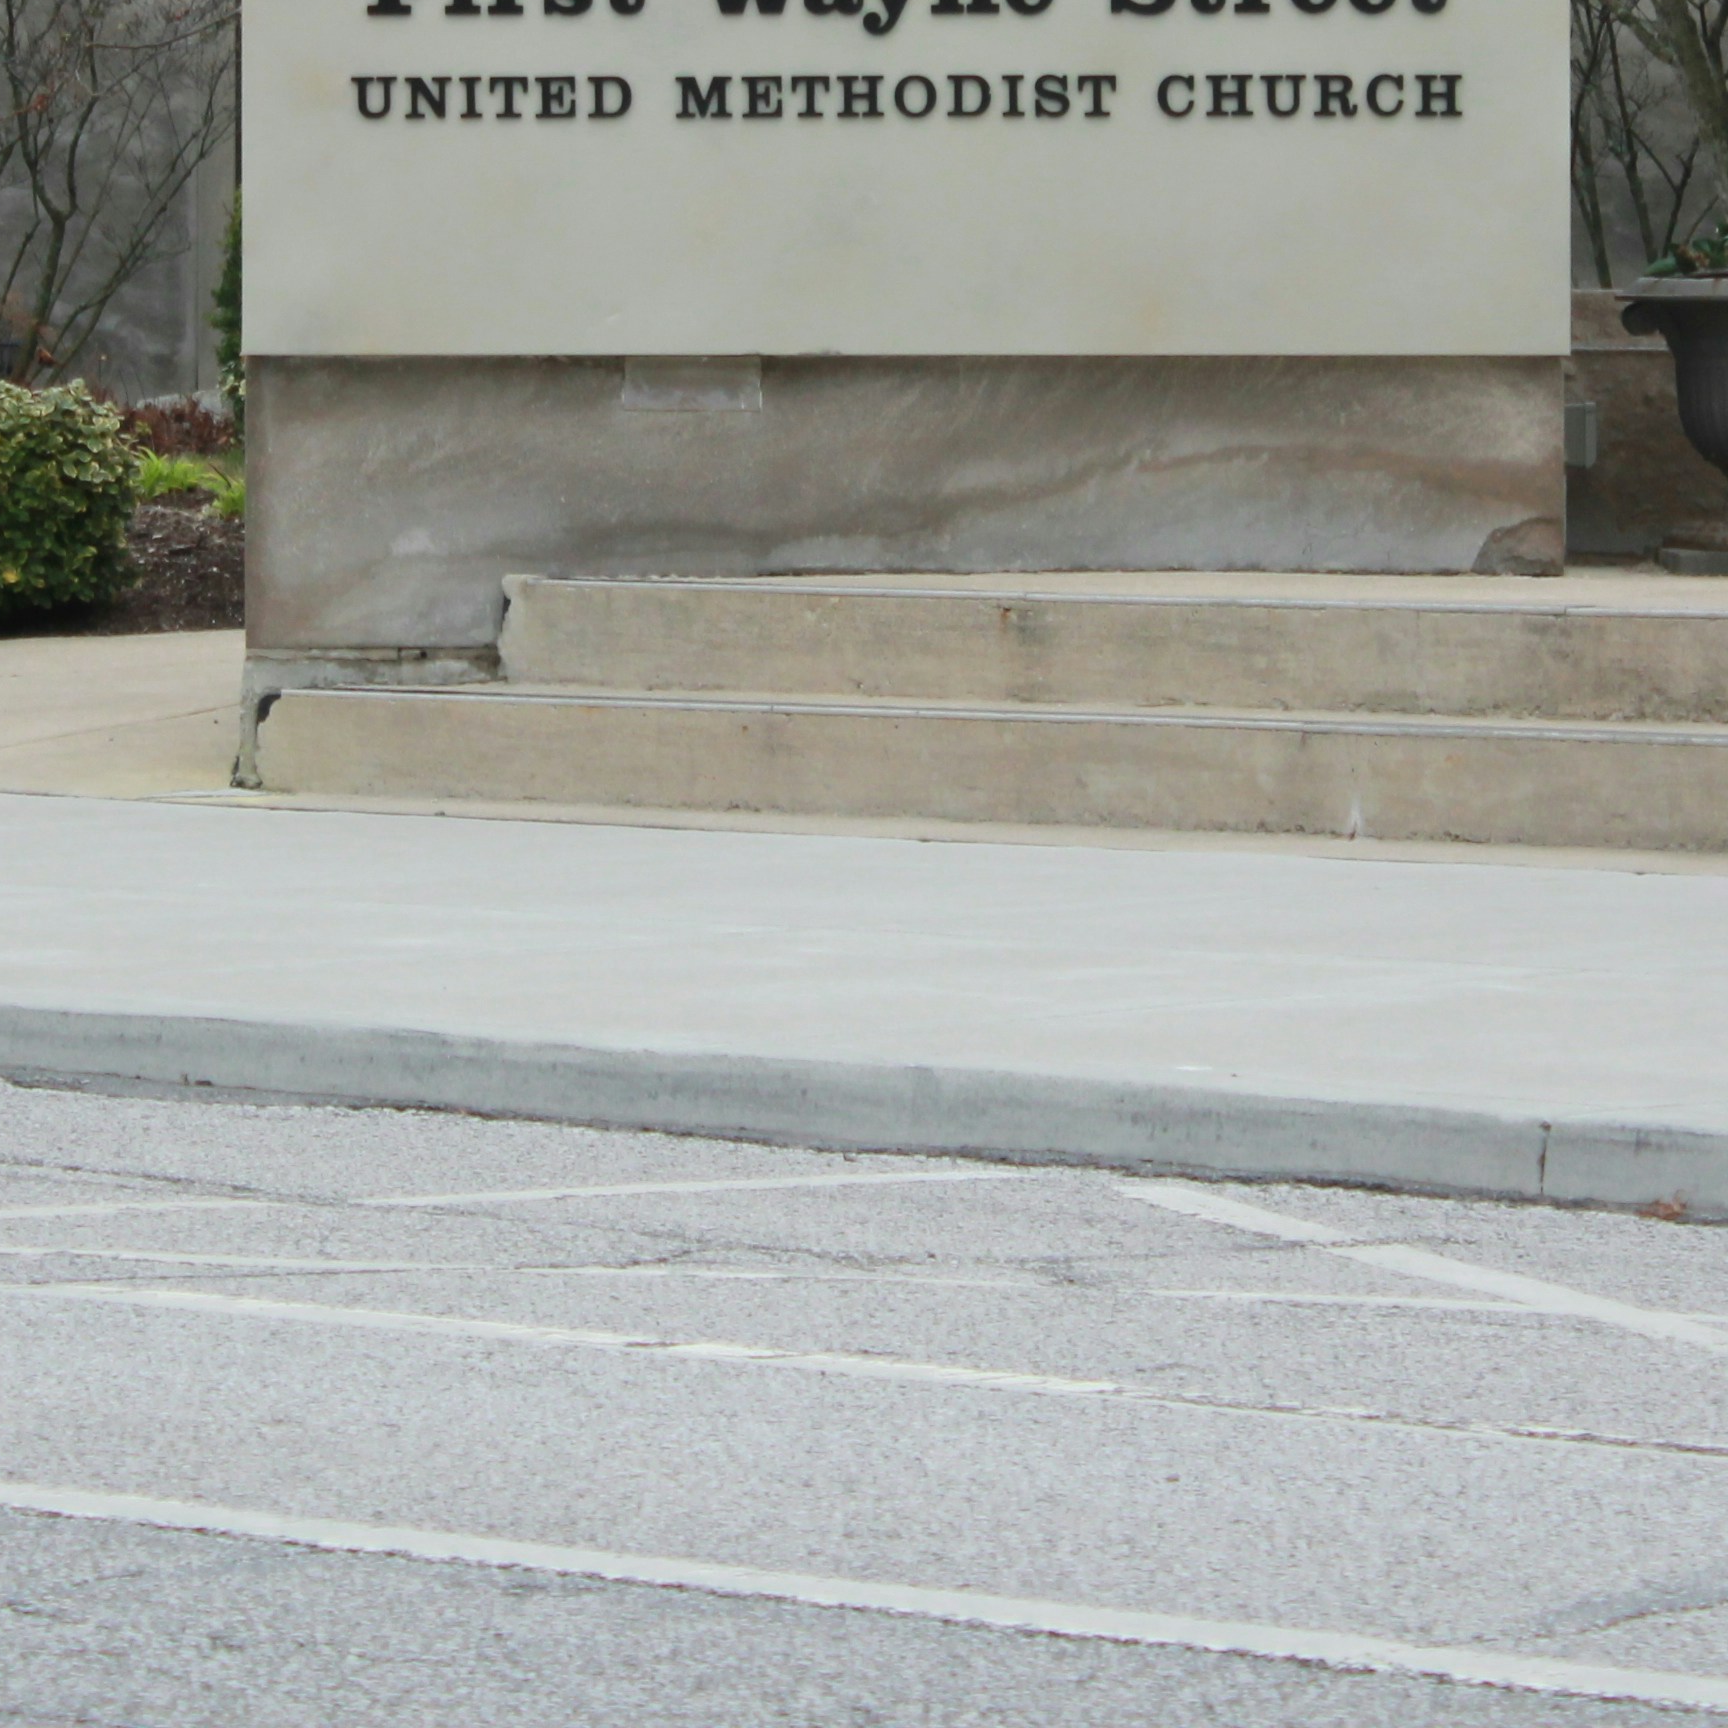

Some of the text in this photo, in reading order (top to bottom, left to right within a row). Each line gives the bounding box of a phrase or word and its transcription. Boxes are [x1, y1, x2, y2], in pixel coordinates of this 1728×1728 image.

[350, 73, 1464, 121] UNITED METHODIST CHURCH
